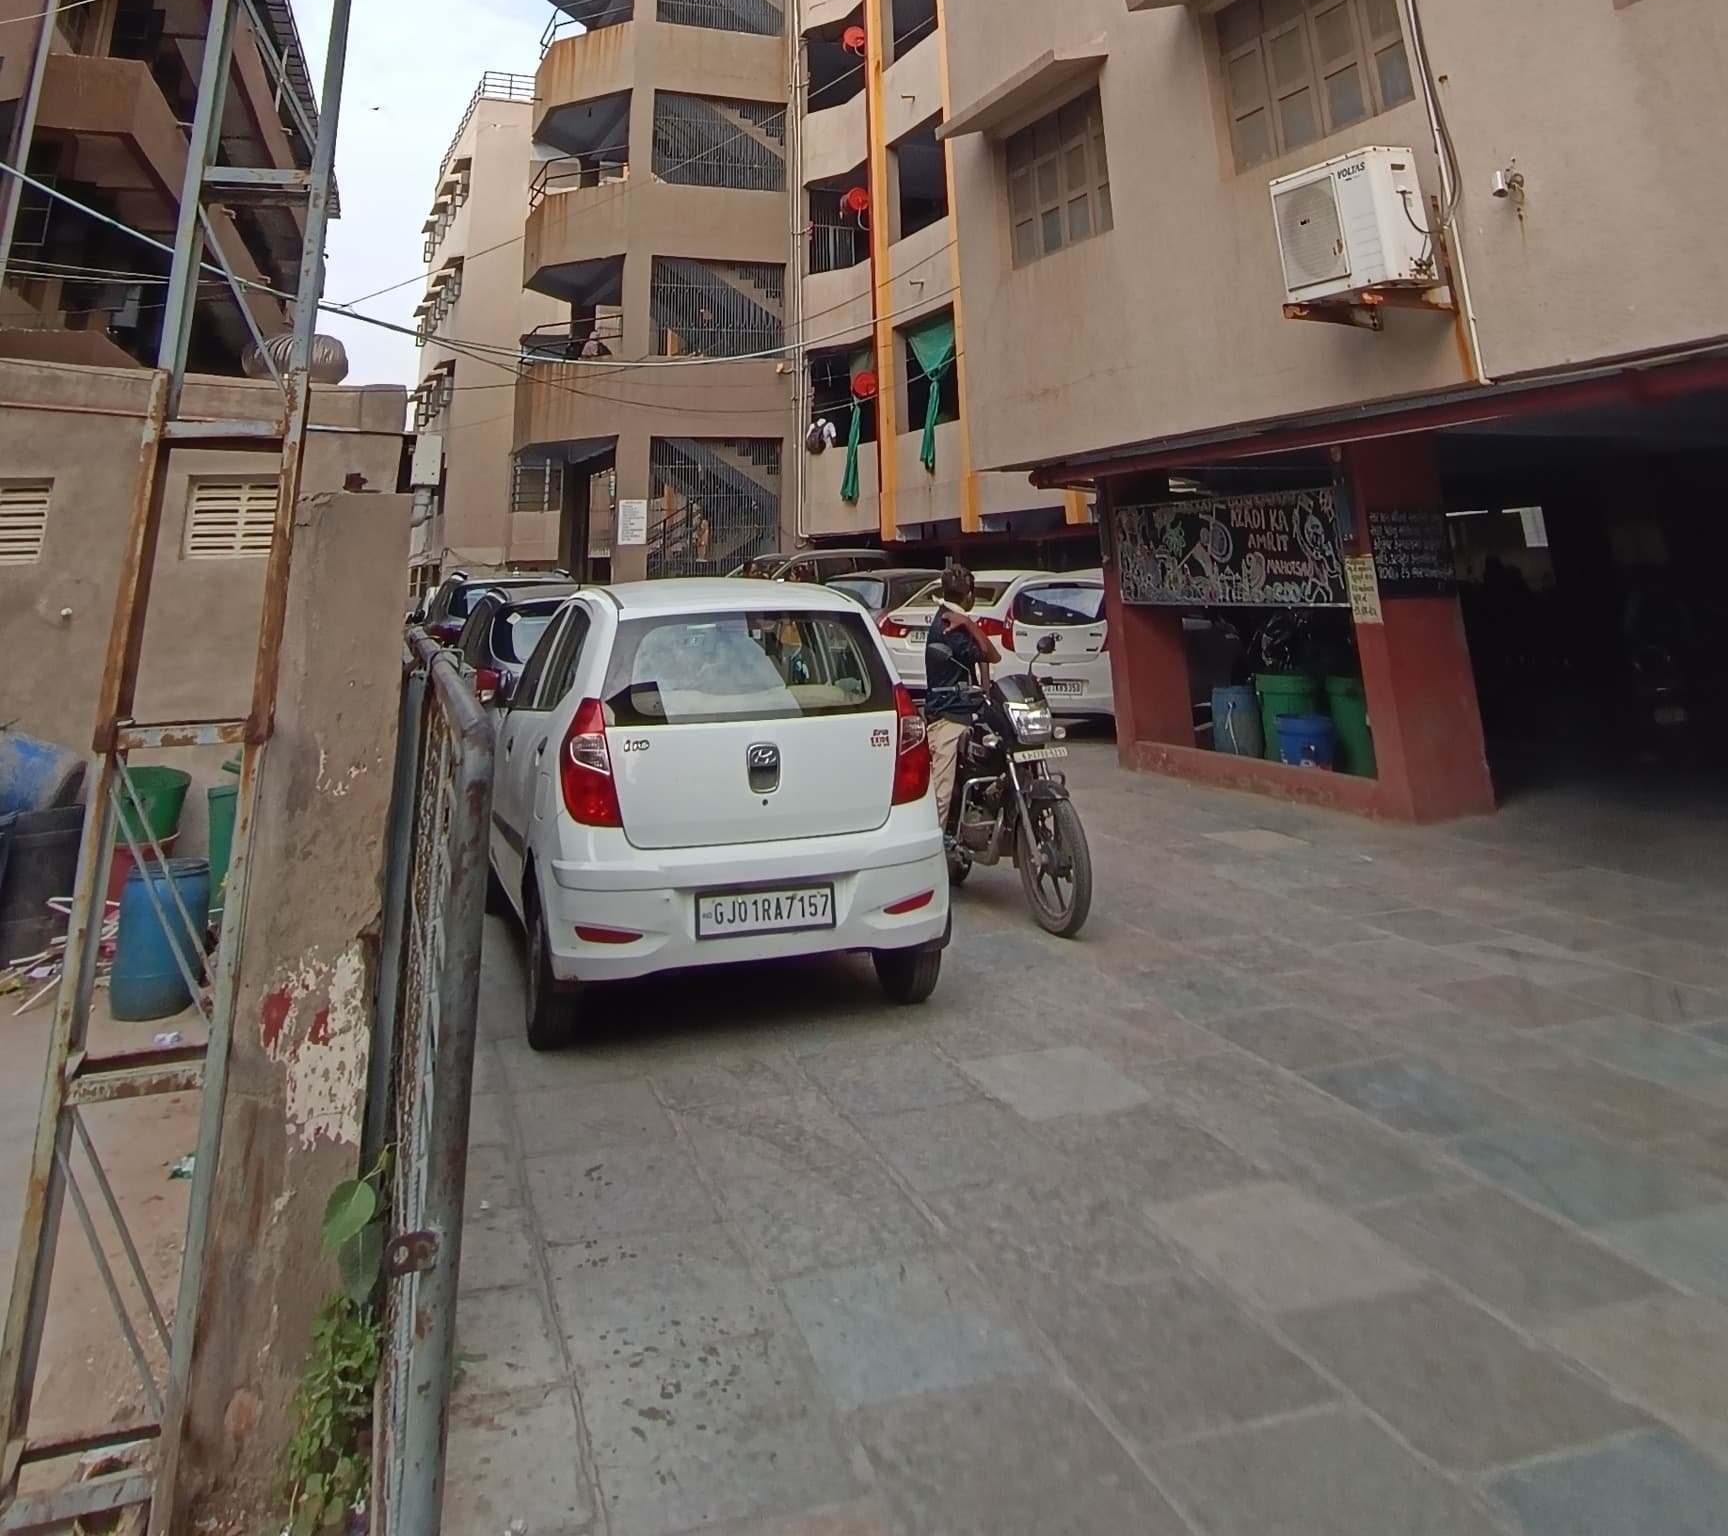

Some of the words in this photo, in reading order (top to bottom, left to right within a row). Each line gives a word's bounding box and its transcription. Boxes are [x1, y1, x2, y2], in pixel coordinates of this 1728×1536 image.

[1337, 161, 1366, 180] VOLTAS
[1230, 508, 1266, 530] AZADI
[1269, 509, 1289, 532] KA
[1247, 532, 1290, 552] AMRIT
[713, 894, 830, 925] GJ01RA7157
